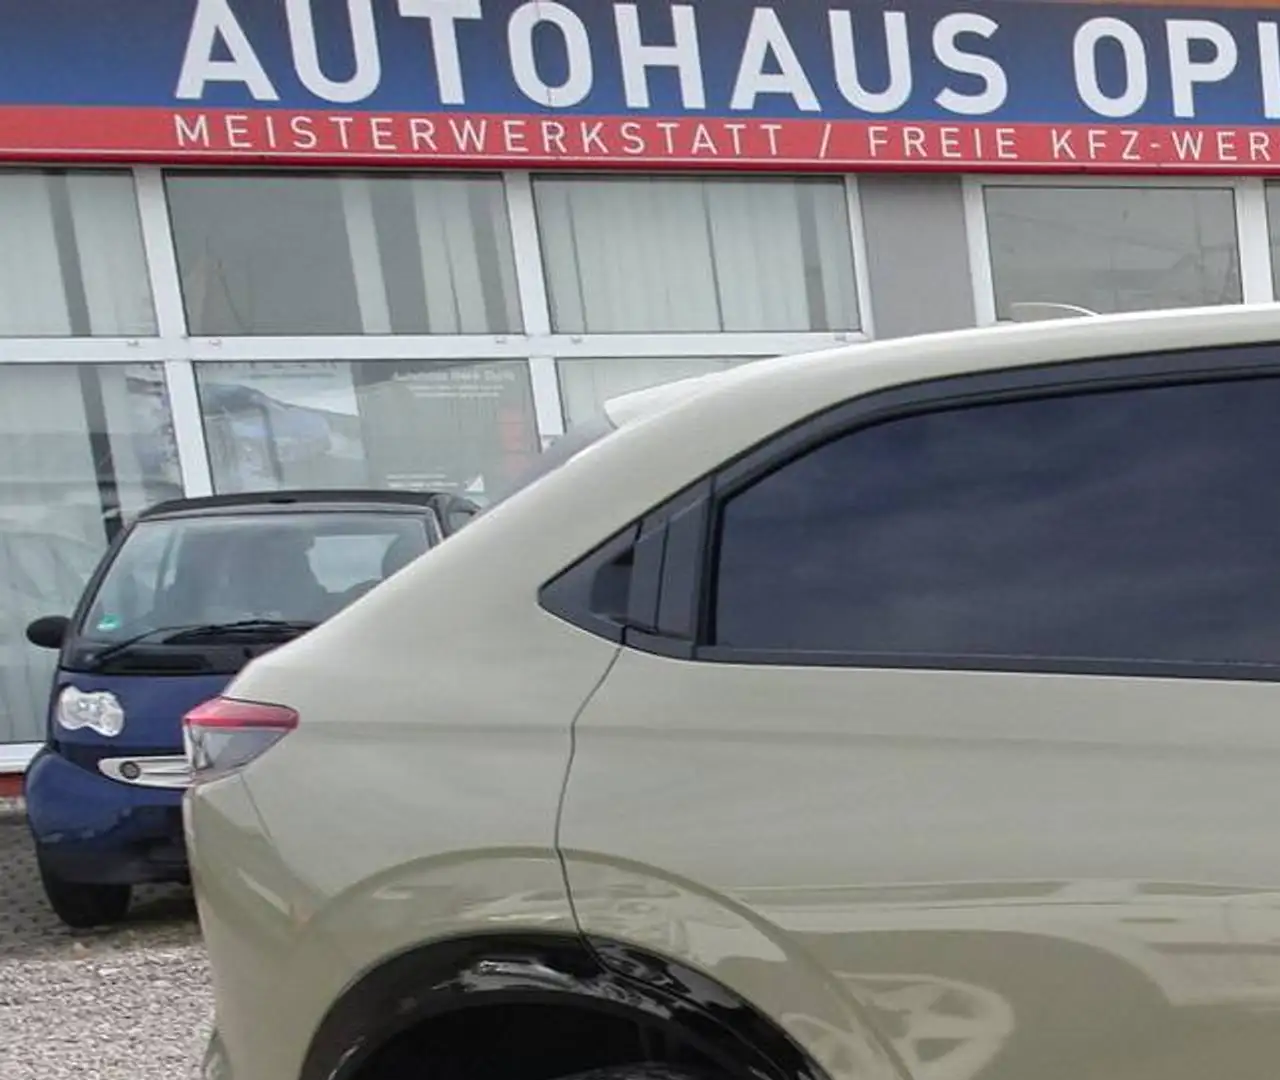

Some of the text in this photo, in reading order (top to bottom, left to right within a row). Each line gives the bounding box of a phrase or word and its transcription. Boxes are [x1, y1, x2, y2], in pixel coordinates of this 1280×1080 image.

[175, 0, 1008, 115] AUTOHAUS
[174, 115, 784, 157] MEISTERWERKSTATT
[868, 125, 1019, 160] FREIE
